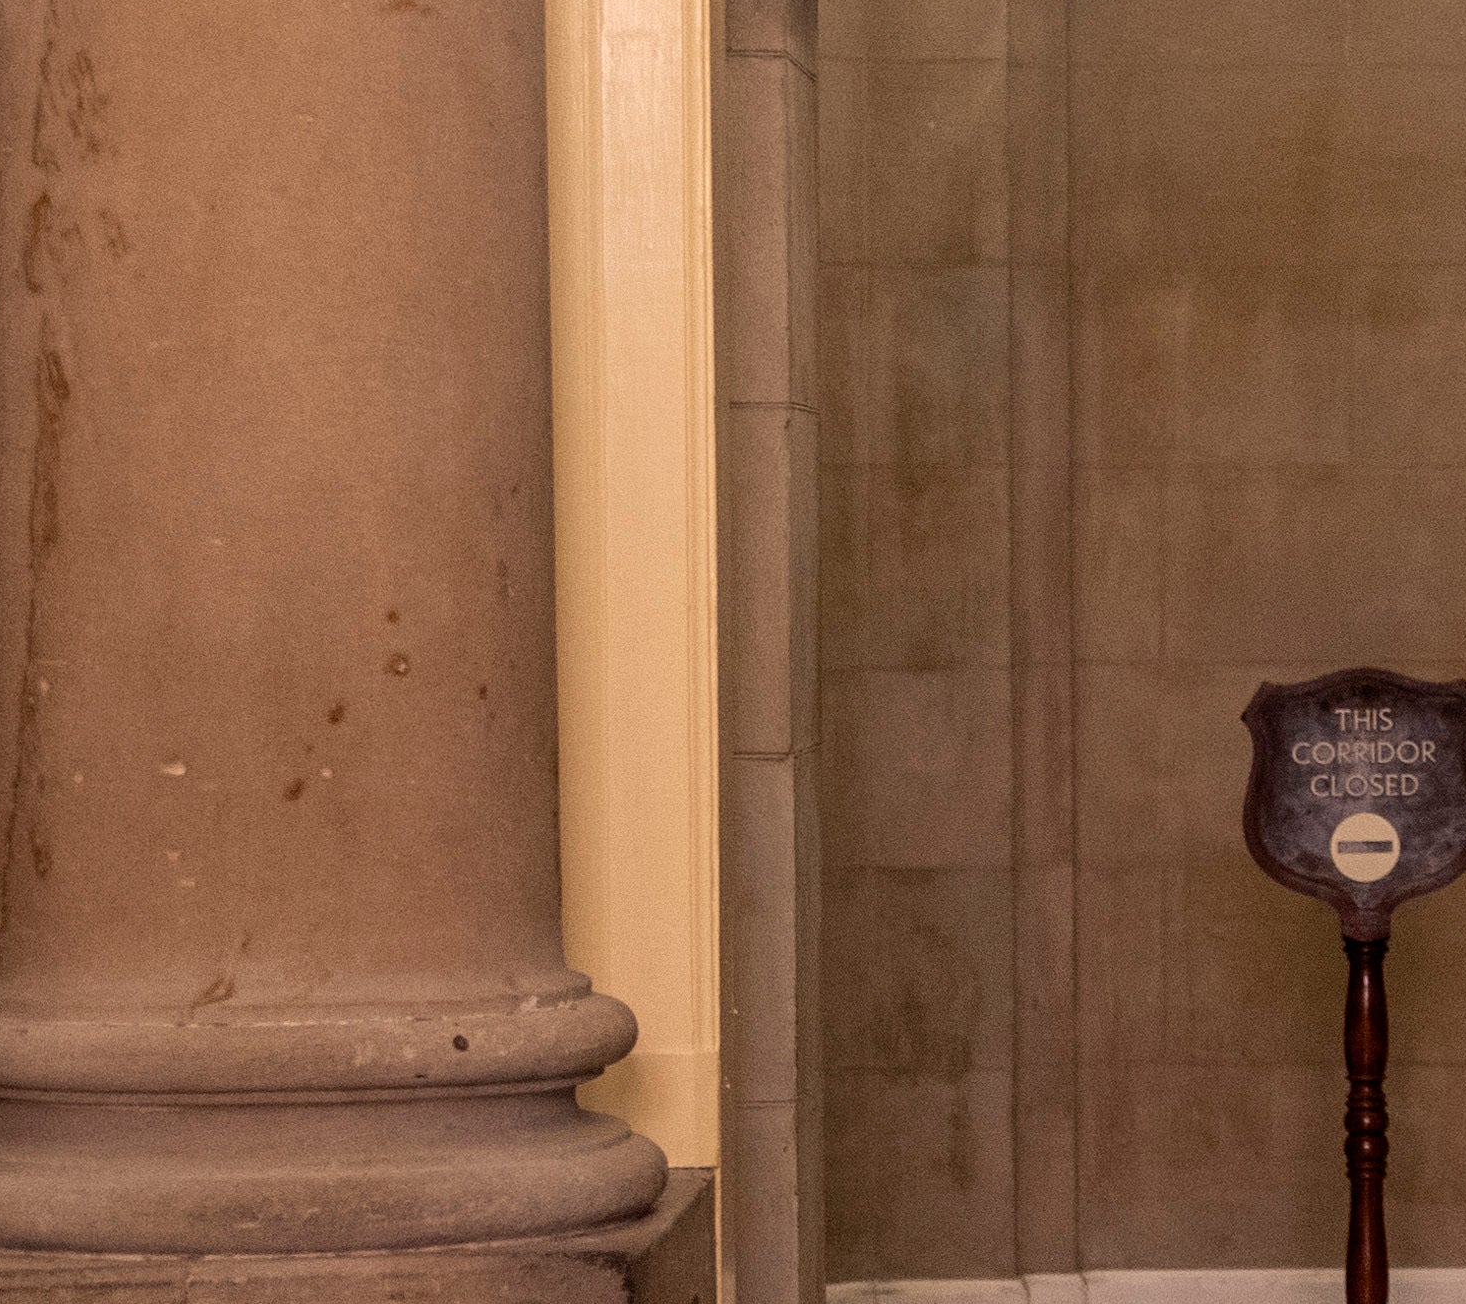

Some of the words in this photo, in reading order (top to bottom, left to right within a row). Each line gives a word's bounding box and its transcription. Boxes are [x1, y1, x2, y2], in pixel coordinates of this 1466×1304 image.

[1334, 708, 1394, 731] THIS
[1292, 740, 1436, 765] CORRIDOR
[1310, 773, 1419, 797] CLOSED
